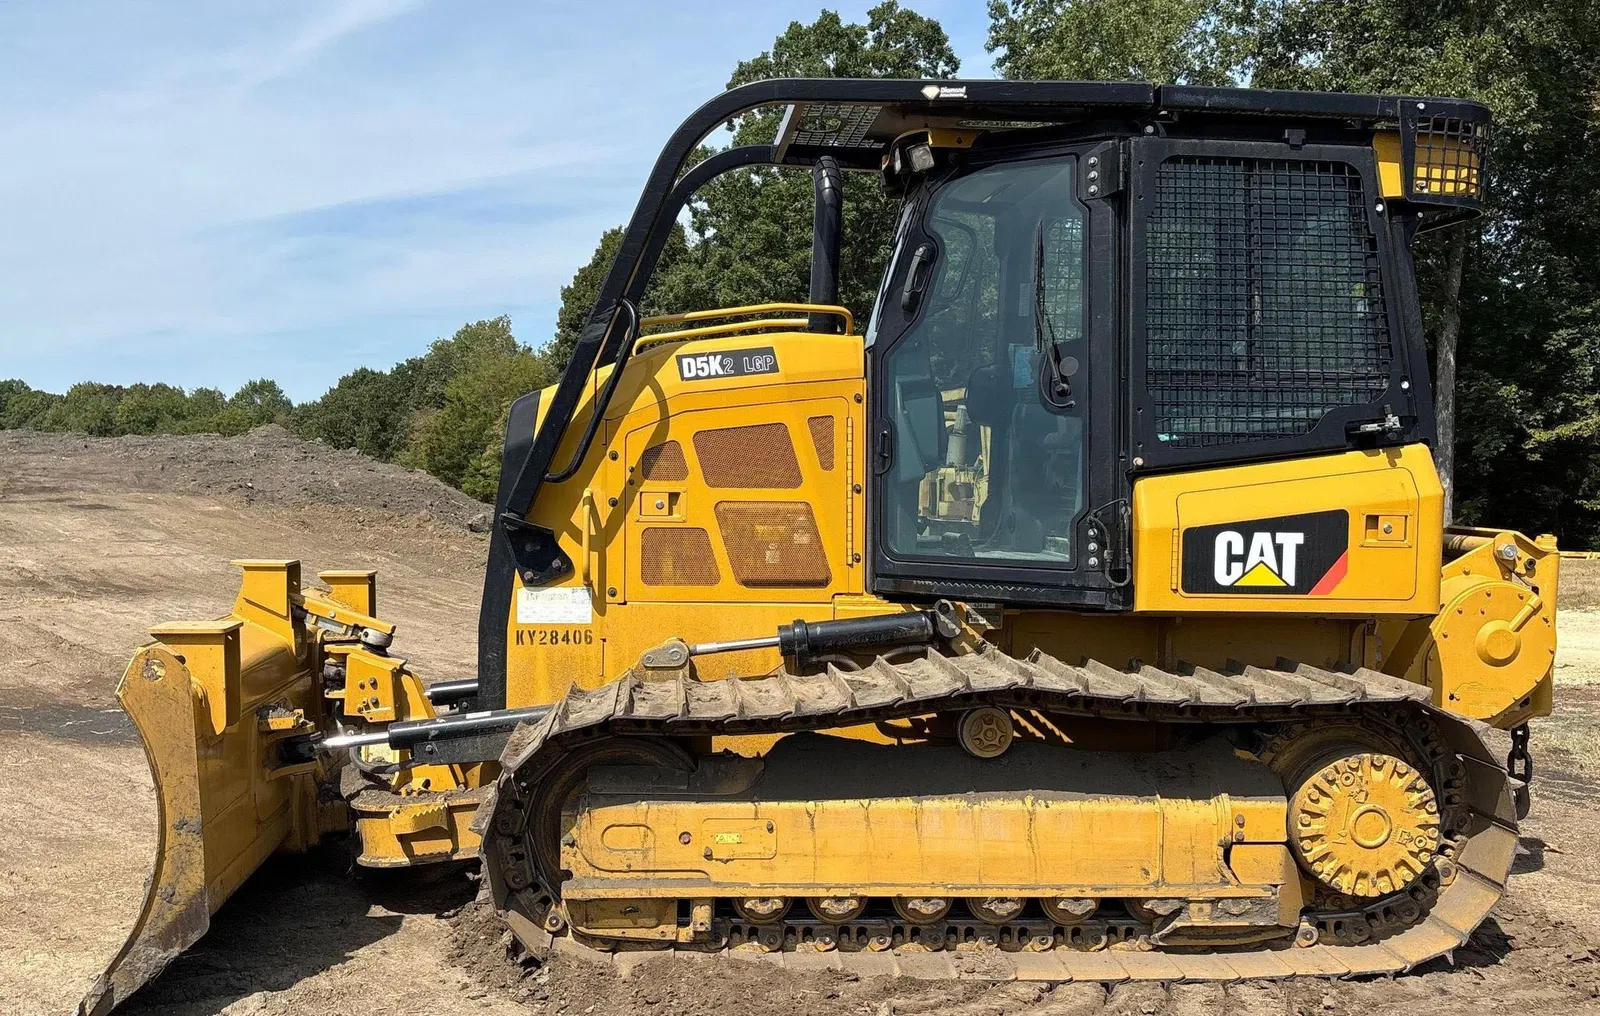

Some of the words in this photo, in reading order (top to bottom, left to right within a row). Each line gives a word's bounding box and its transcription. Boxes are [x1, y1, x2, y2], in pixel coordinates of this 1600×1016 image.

[940, 86, 966, 94] Diamond
[743, 354, 774, 373] LGP
[1214, 530, 1304, 587] CAT
[515, 629, 593, 646] KY28406
